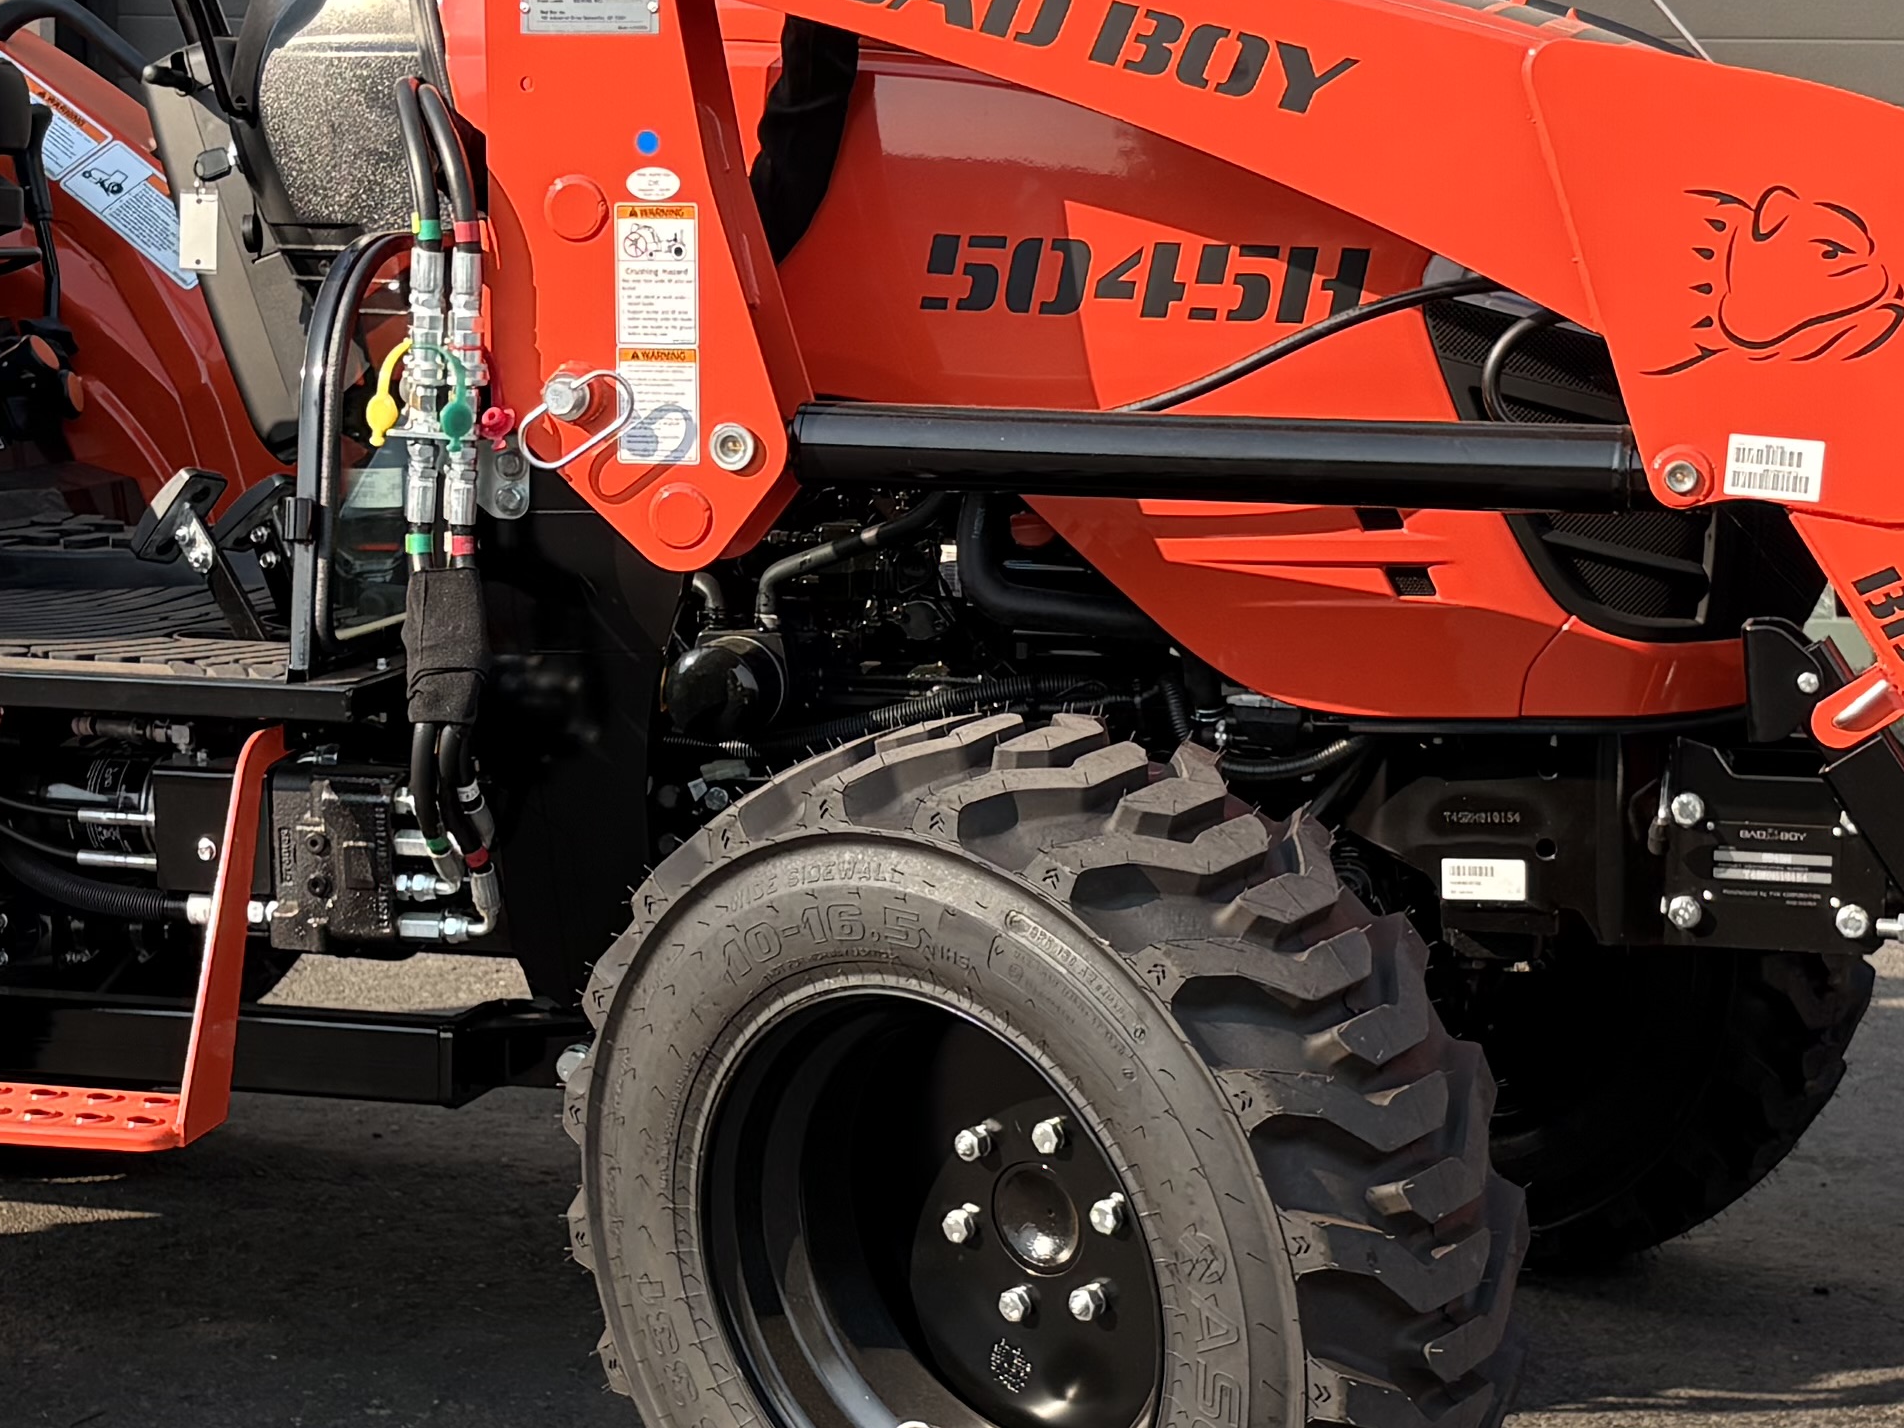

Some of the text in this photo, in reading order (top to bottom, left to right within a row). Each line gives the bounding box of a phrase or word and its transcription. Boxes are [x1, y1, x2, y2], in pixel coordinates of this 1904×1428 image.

[1089, 0, 1361, 114] BOY
[639, 207, 685, 218] WARNING
[920, 233, 1371, 324] 5045H
[641, 350, 687, 361] WARNING
[787, 861, 903, 887] SIDEWALL
[723, 903, 924, 980] 10-16.5
